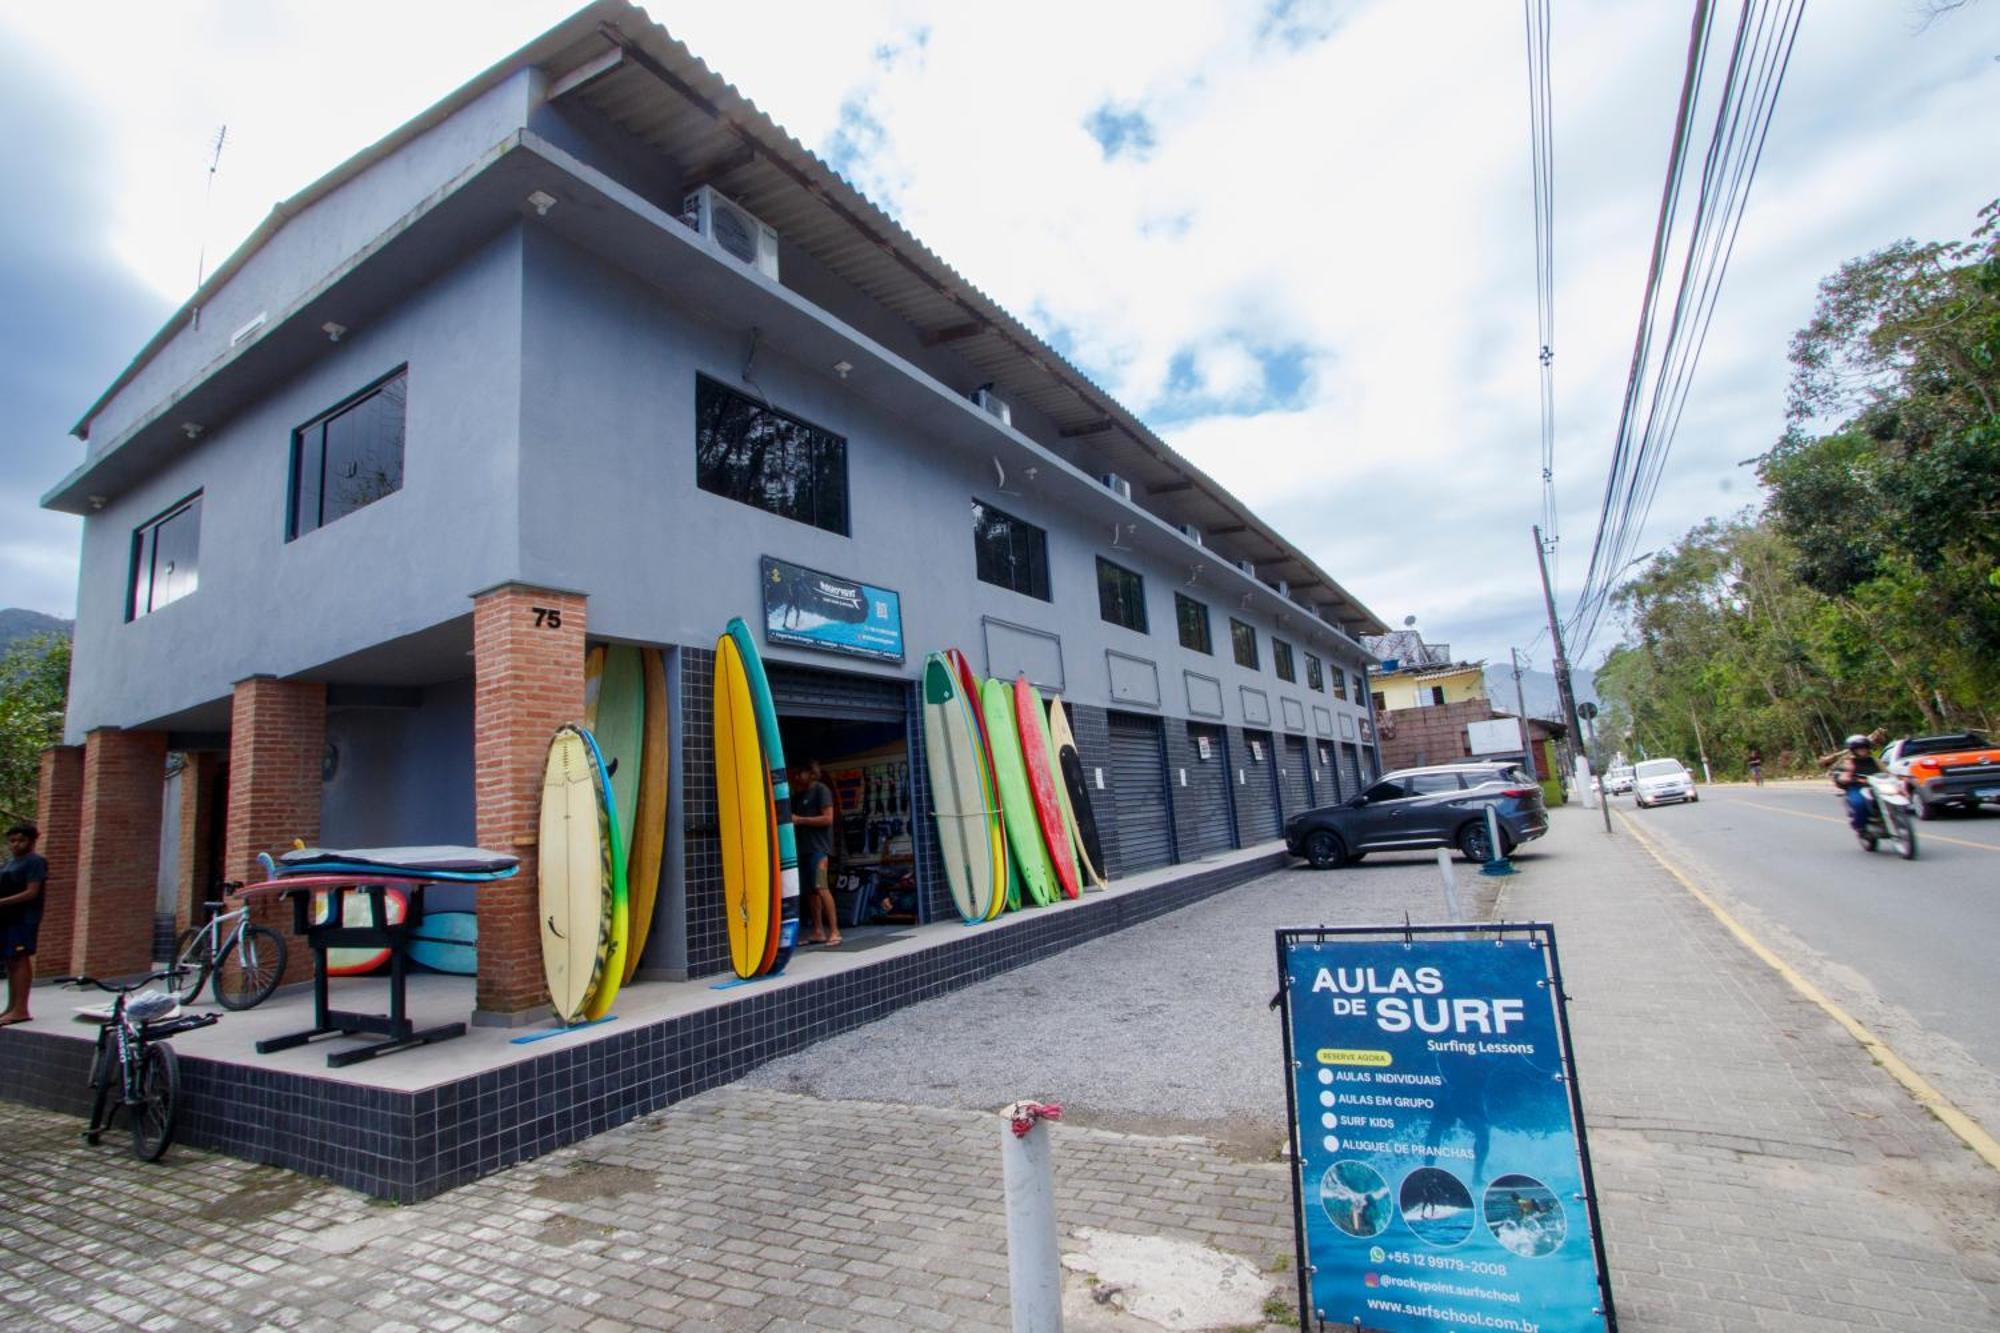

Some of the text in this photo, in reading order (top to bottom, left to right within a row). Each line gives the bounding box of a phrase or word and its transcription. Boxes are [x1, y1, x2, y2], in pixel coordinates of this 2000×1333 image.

[532, 607, 561, 628] 75
[1312, 967, 1444, 995] AULAS
[1333, 998, 1524, 1034] DE SURF
[1427, 1040, 1535, 1055] Surfing Lessons
[1323, 1052, 1386, 1062] RESERVE AGORA
[1336, 1071, 1442, 1086] AULAS INDIVIDUAIS
[1338, 1094, 1434, 1109] AULAS EM GRUPO
[1340, 1115, 1394, 1129] SURF KIDS
[1342, 1139, 1475, 1159] ALUGUEL DE PRANCHAS
[1388, 1252, 1410, 1265] +55
[1413, 1254, 1425, 1267] 12
[1367, 1298, 1539, 1333] www.surfschool.com.br
